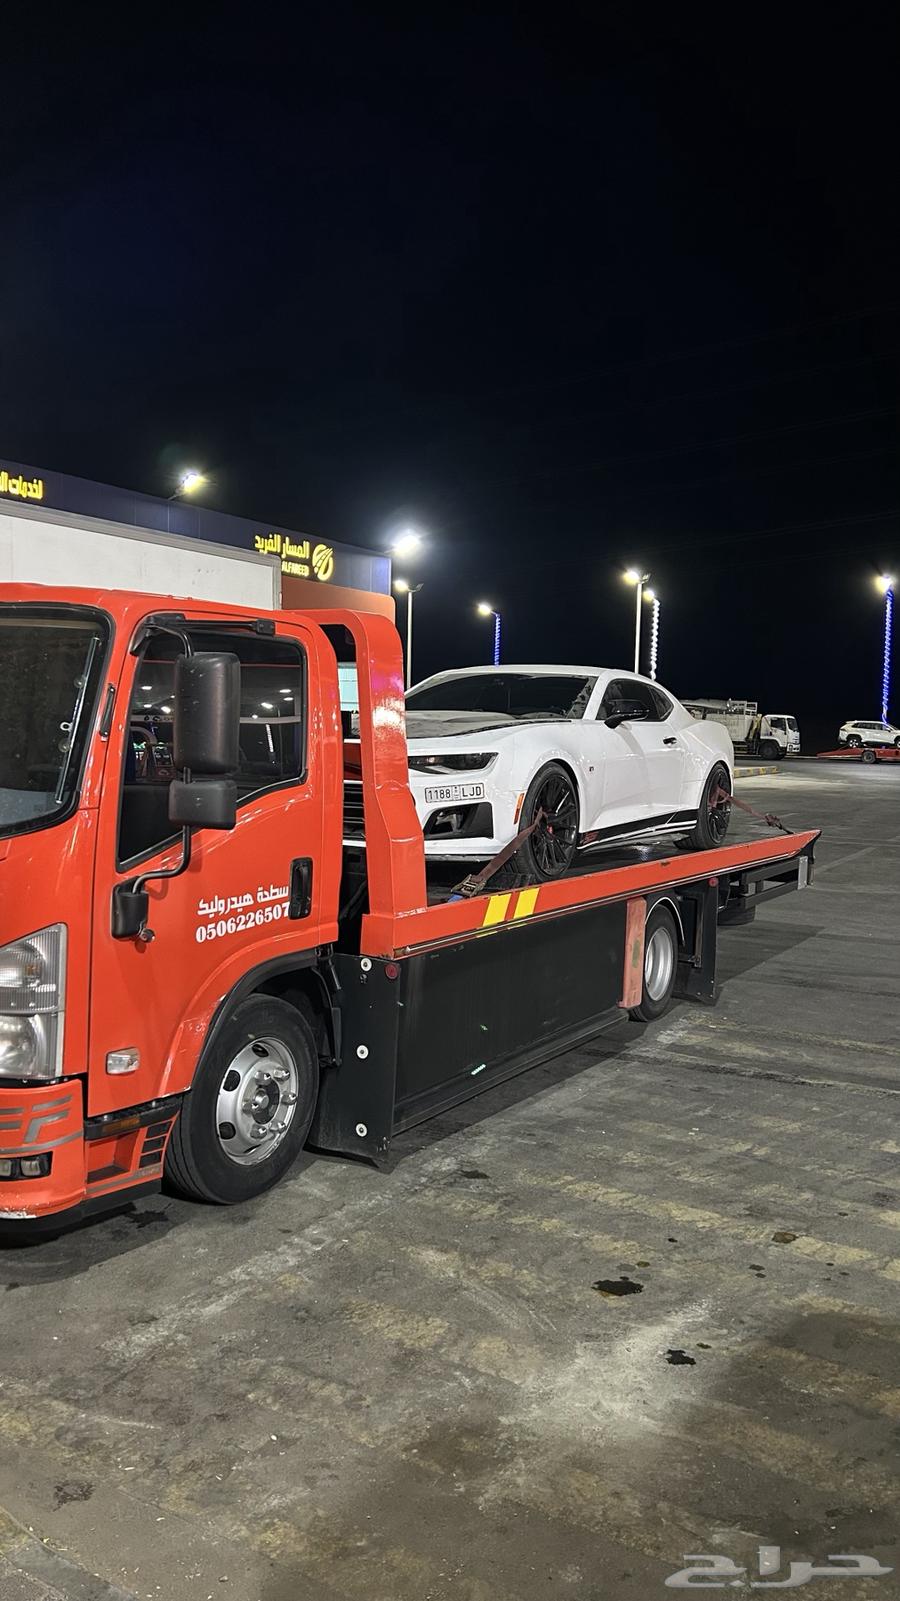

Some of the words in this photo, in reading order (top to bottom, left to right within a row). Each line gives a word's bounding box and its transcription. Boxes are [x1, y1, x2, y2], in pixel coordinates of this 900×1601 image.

[255, 534, 281, 554] الفريد
[281, 536, 310, 559] المسار
[427, 788, 451, 800] 1188
[461, 786, 482, 797] LJD
[257, 884, 289, 903] سطحة
[197, 894, 254, 918] هيدروليك
[195, 901, 290, 943] 0506226507
